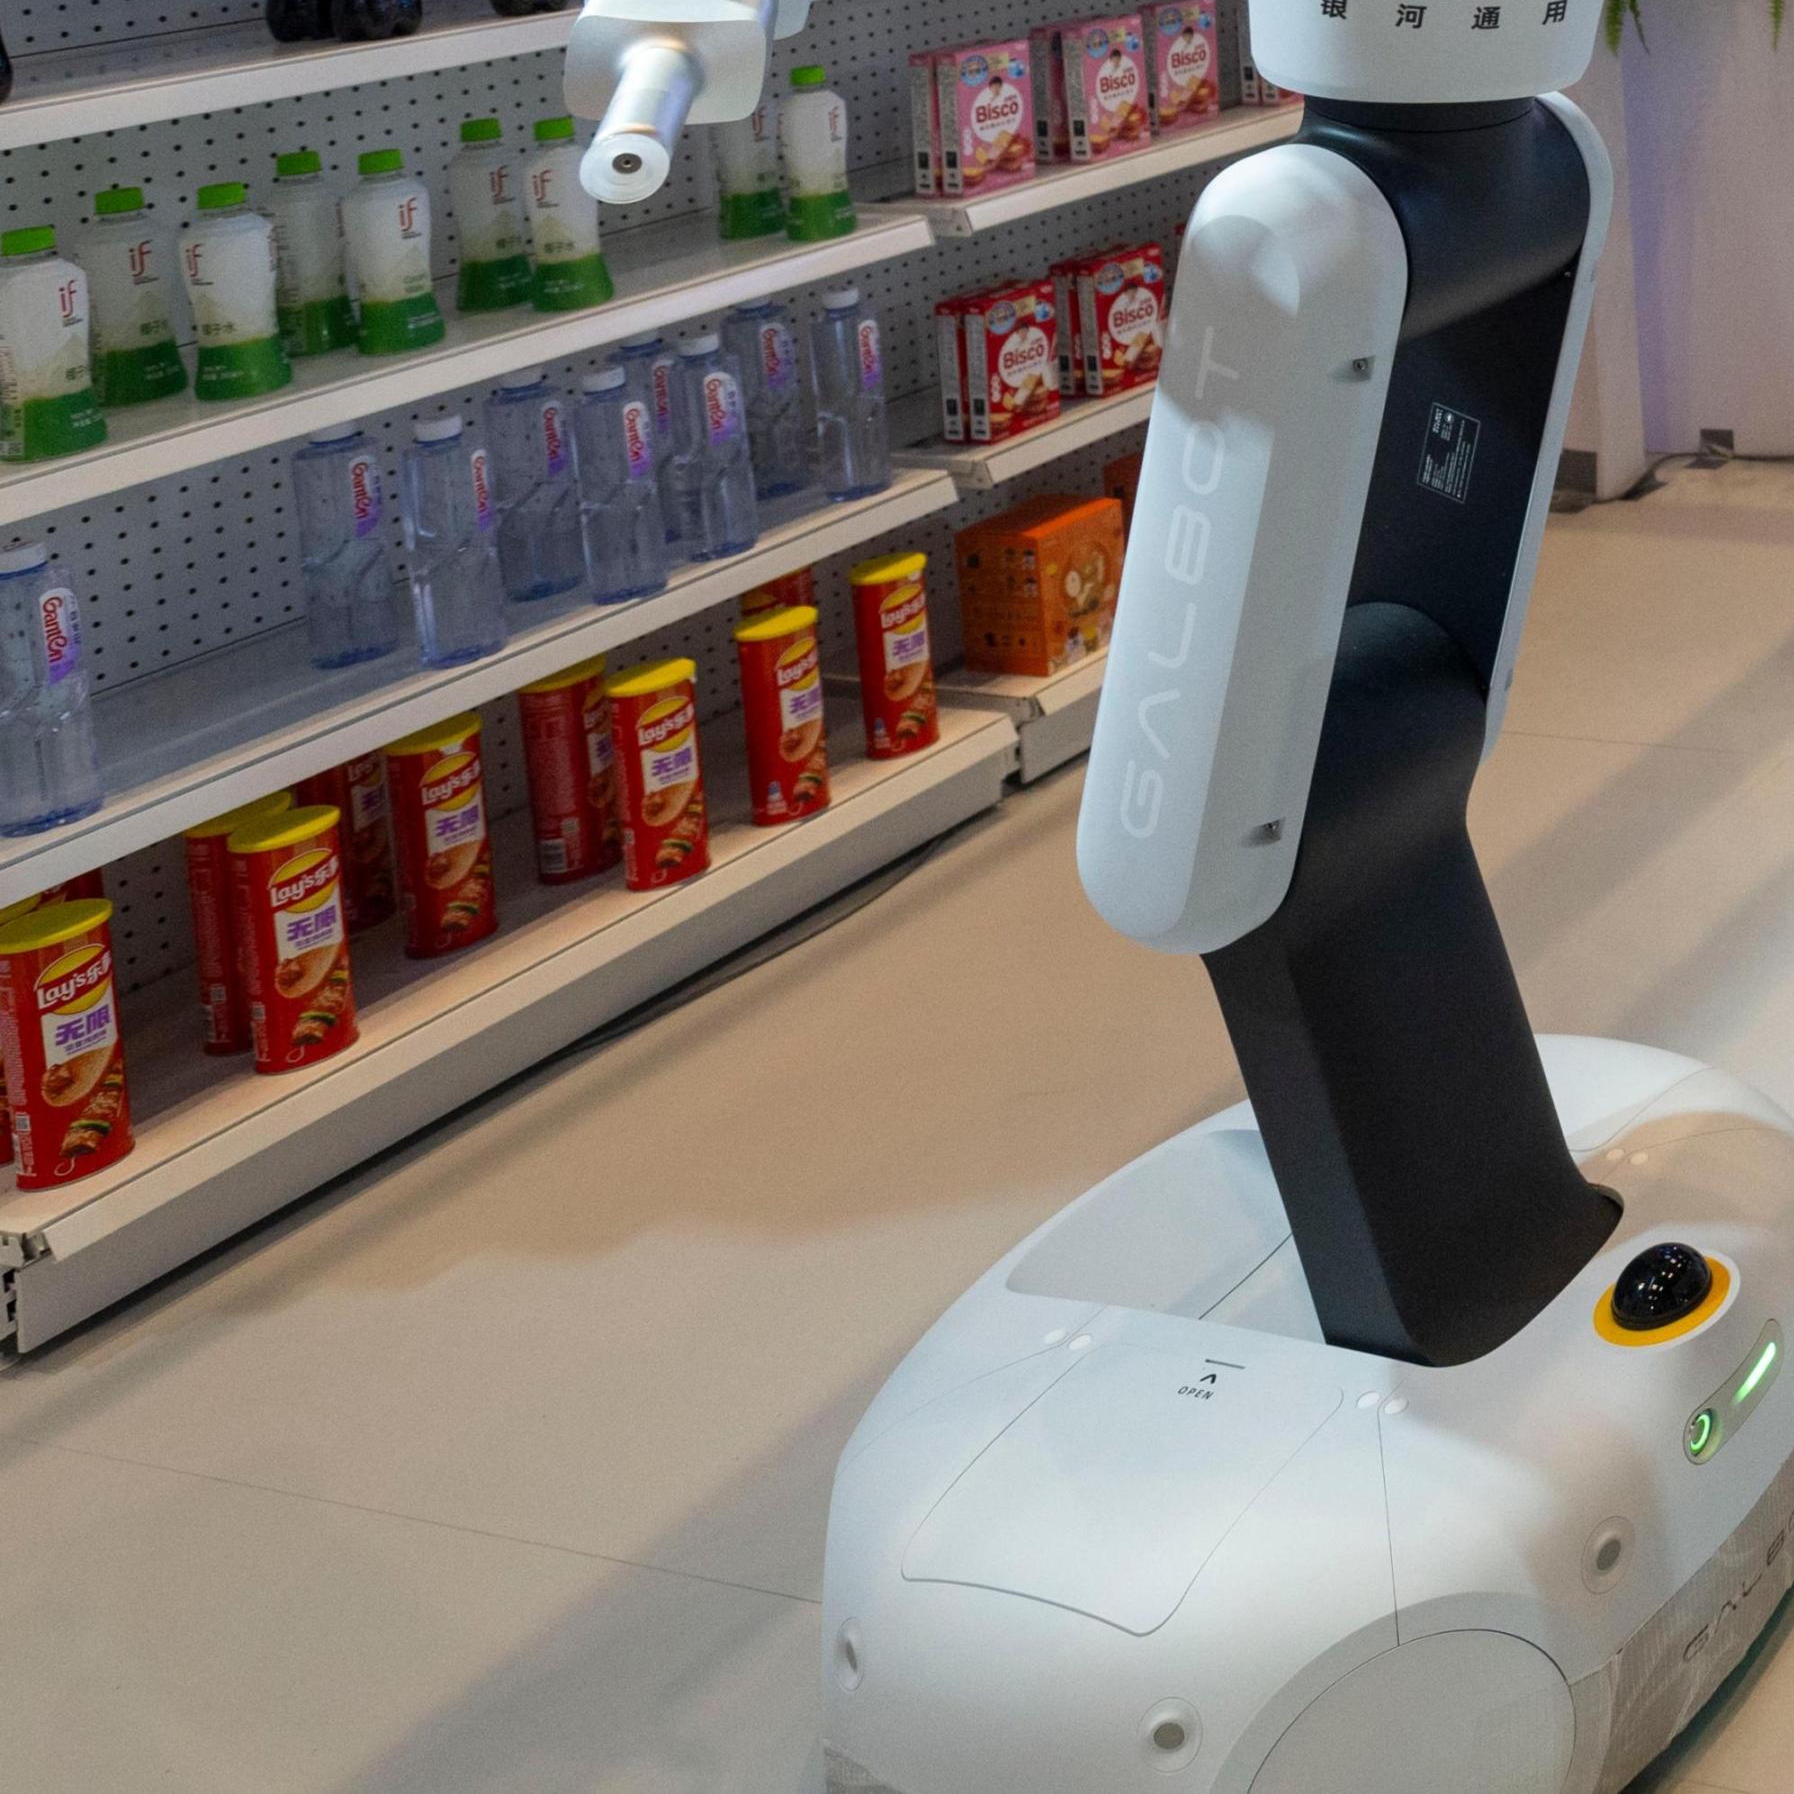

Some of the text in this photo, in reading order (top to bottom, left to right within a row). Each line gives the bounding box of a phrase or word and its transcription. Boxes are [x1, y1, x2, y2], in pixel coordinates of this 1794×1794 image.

[1171, 47, 1207, 69] Bisco
[1100, 71, 1136, 94] Bisco
[975, 100, 1019, 124] Bisco
[397, 197, 418, 232] if
[129, 240, 152, 277] if
[58, 279, 78, 319] if
[1113, 304, 1155, 329] Bisco
[1003, 344, 1045, 369] Bisco
[1119, 325, 1240, 838] GALBOT
[270, 873, 315, 907] Lay's
[37, 972, 85, 1010] Lay's
[1177, 1386, 1215, 1400] OPEN
